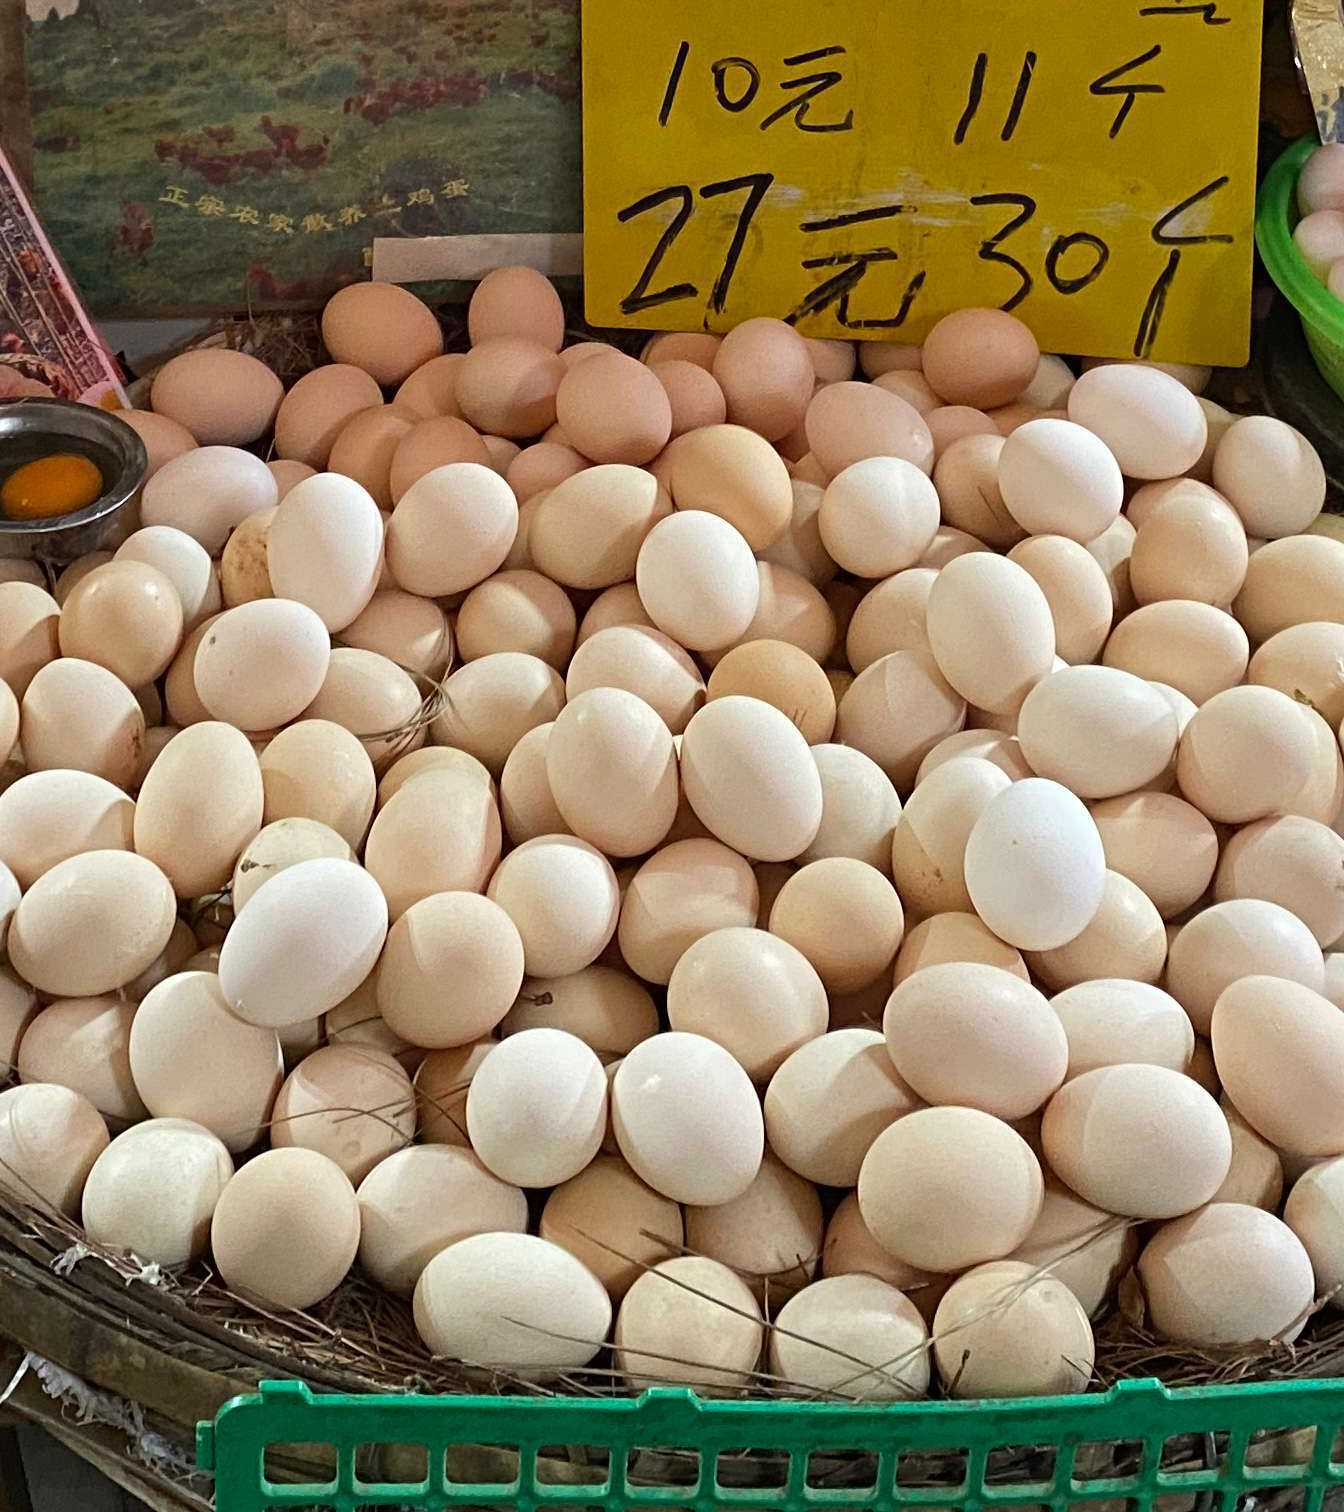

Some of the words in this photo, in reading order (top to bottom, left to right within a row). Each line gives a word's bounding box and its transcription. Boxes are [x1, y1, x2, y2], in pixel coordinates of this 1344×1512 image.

[159, 179, 470, 234] 正宗农家散养土鸡蛋
